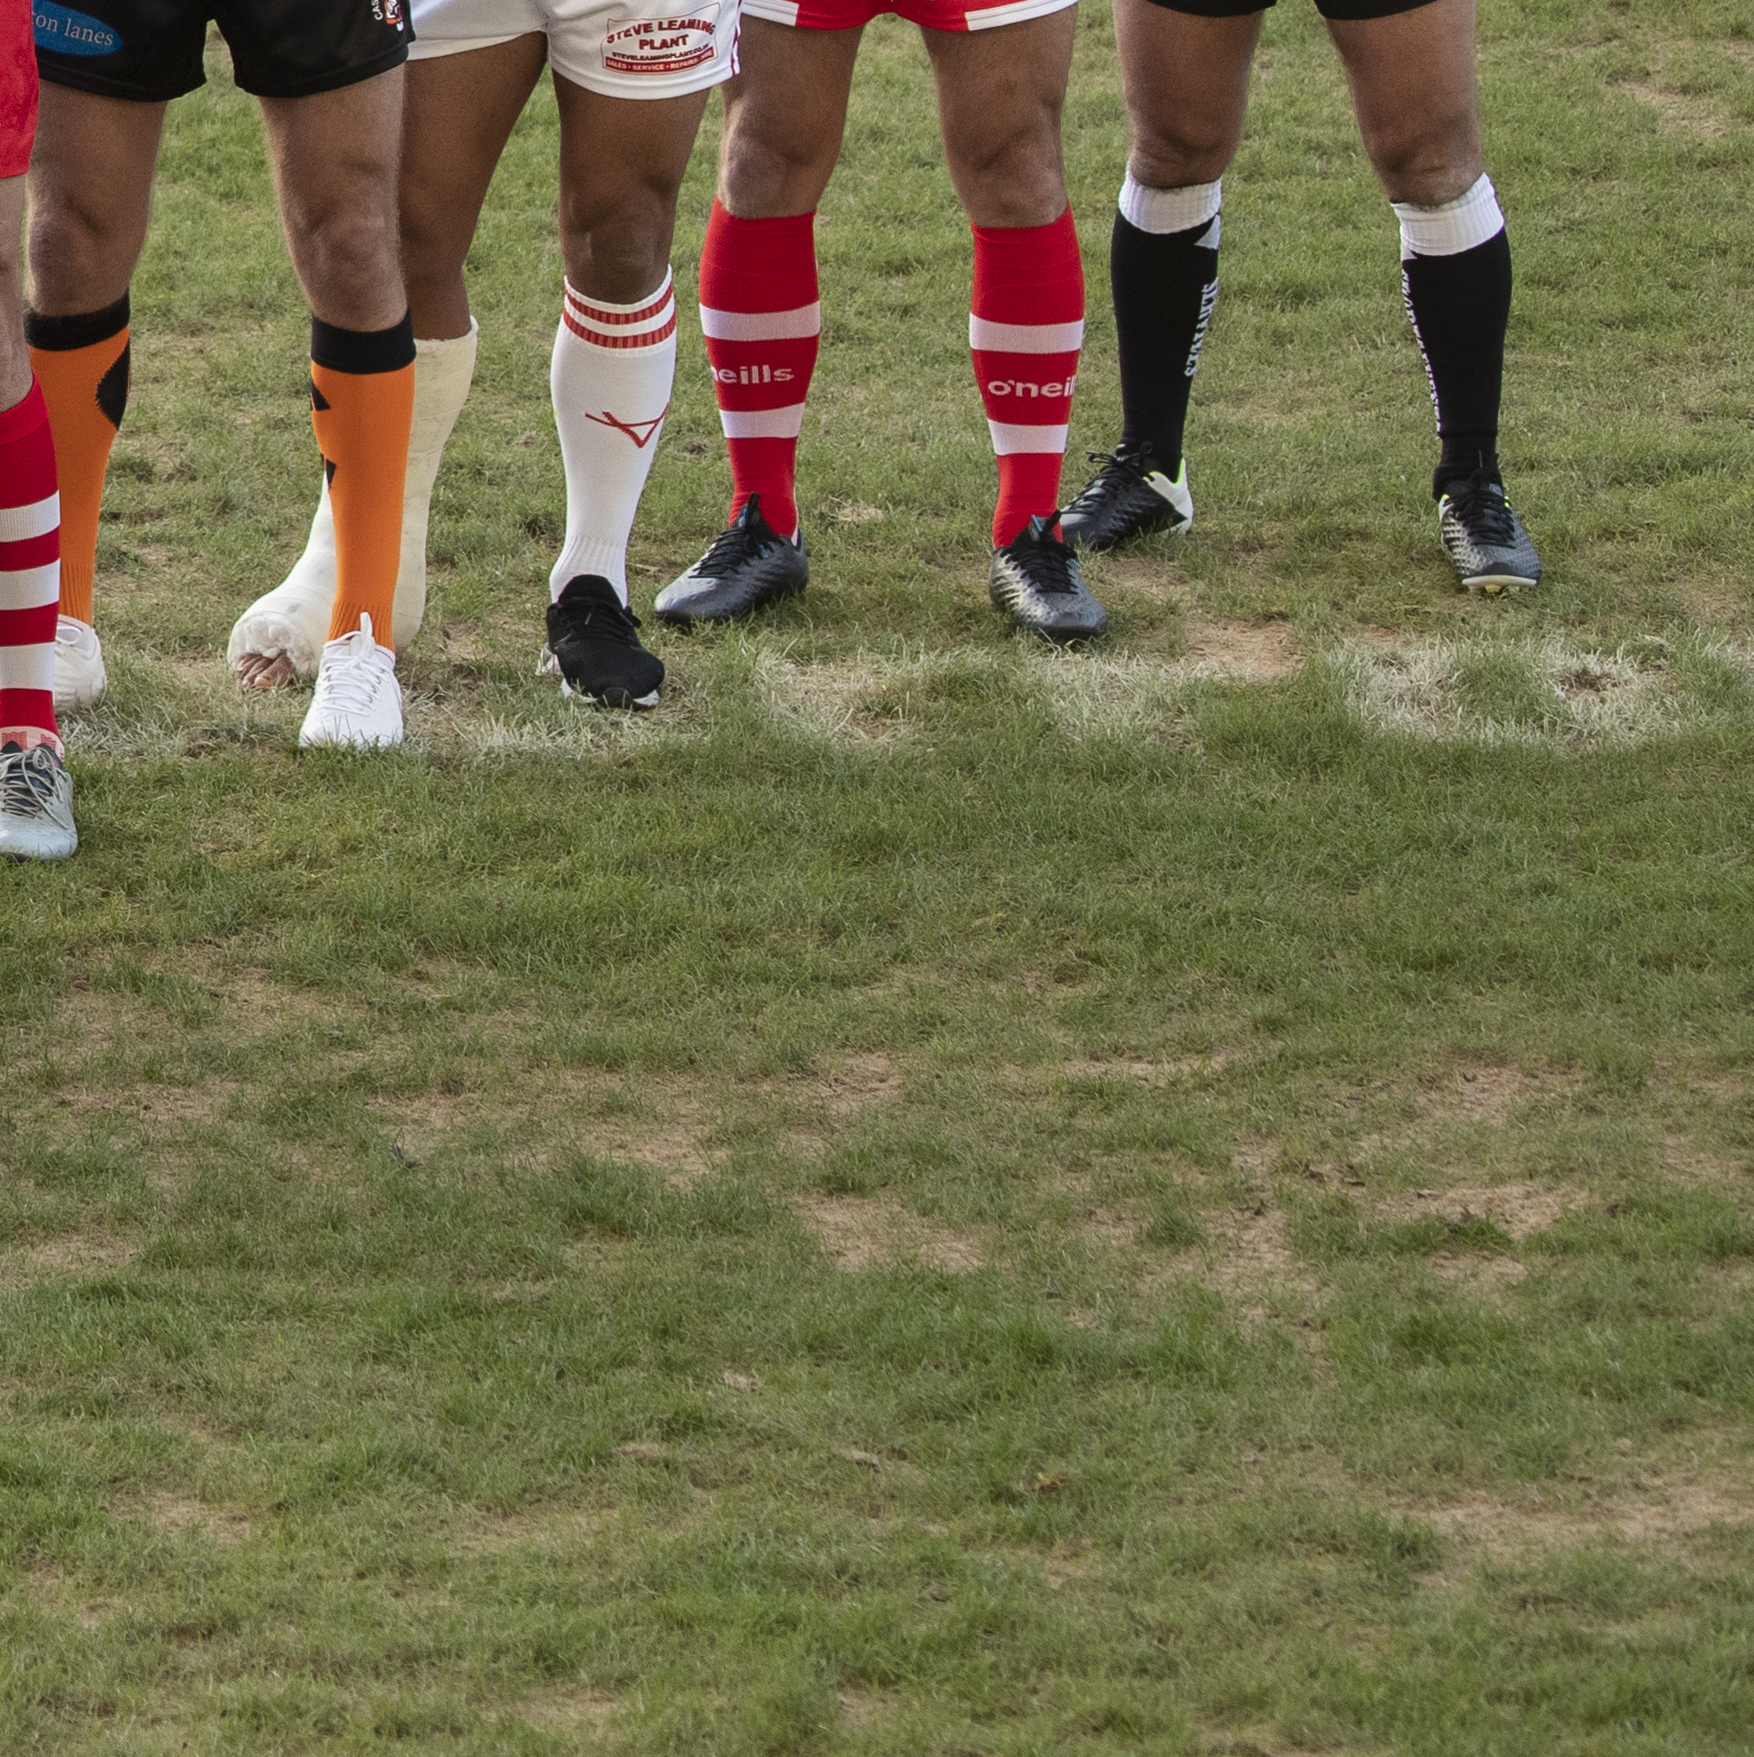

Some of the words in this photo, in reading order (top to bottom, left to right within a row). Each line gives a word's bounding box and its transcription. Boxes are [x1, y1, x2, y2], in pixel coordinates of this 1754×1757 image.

[64, 17, 114, 47] lanes
[606, 22, 654, 44] STEVE
[638, 34, 689, 51] PLANT
